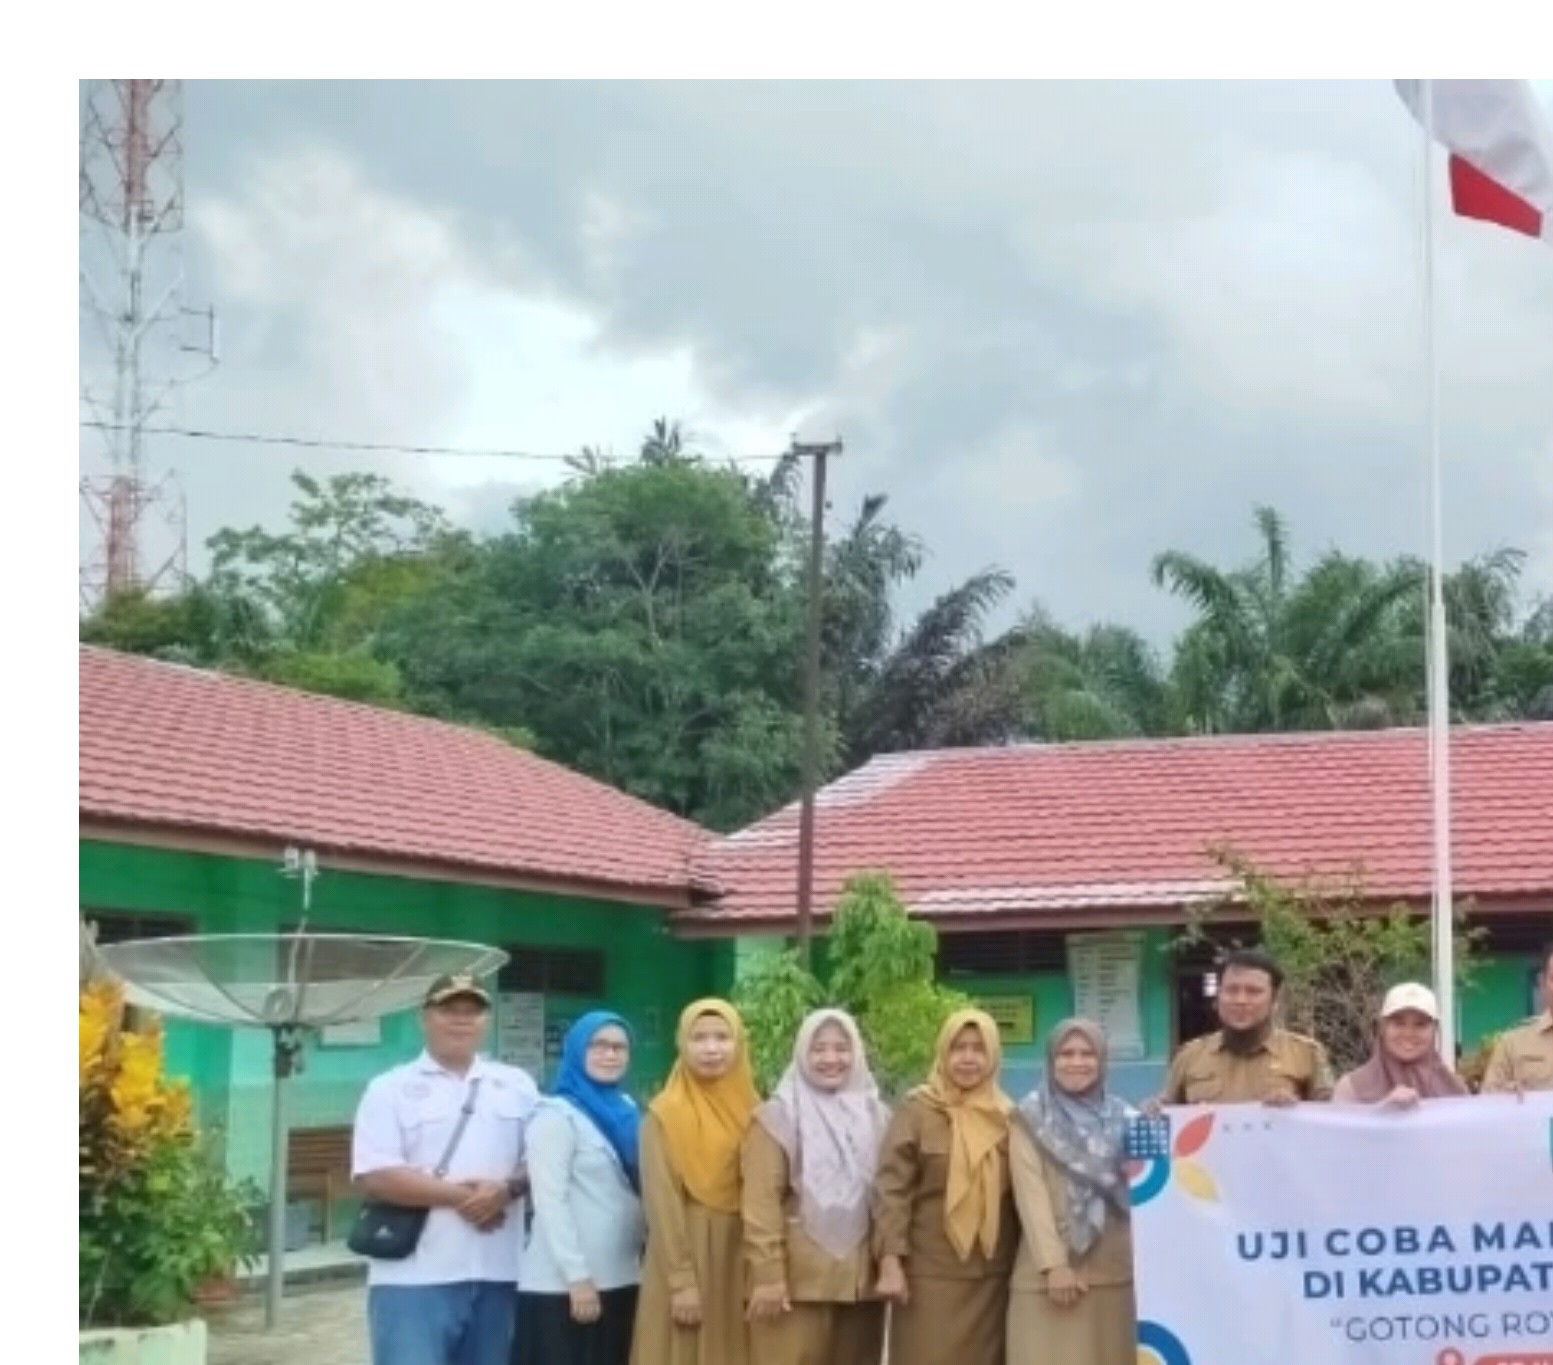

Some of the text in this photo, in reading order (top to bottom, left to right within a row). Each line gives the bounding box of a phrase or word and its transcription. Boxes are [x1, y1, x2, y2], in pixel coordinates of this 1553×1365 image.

[1236, 1229, 1308, 1261] UJI
[1324, 1224, 1456, 1257] COBA
[1302, 1268, 1345, 1299] DI
